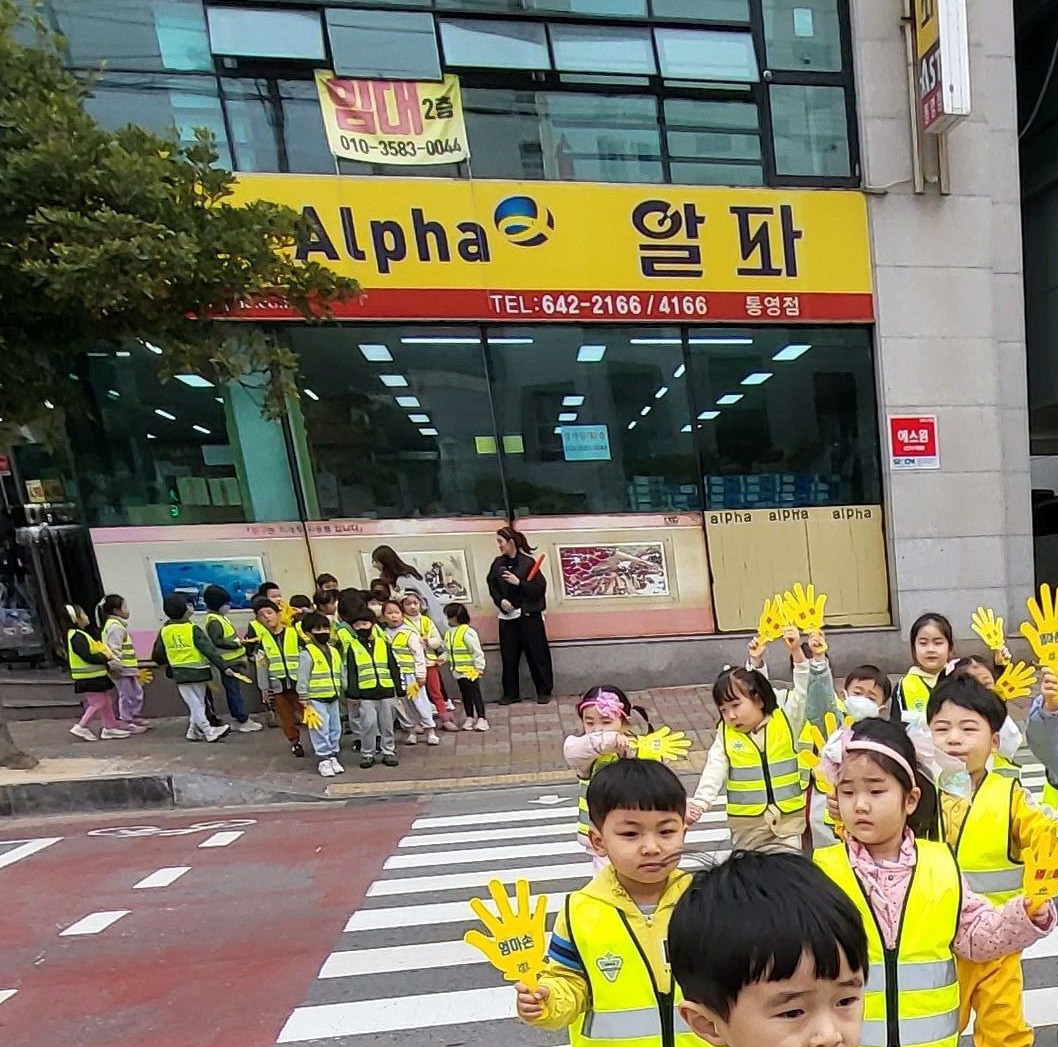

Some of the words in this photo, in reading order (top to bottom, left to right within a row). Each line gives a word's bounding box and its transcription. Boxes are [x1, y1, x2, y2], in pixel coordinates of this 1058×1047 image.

[326, 78, 424, 136] 임대
[422, 95, 454, 121] 2층
[339, 135, 462, 157] 010-3583-0044
[294, 205, 492, 275] Alpha
[744, 295, 801, 317] 통영점
[710, 511, 752, 525] alpha
[768, 508, 810, 522] alpha
[832, 507, 872, 520] alpha
[497, 934, 535, 957] 엄마손
